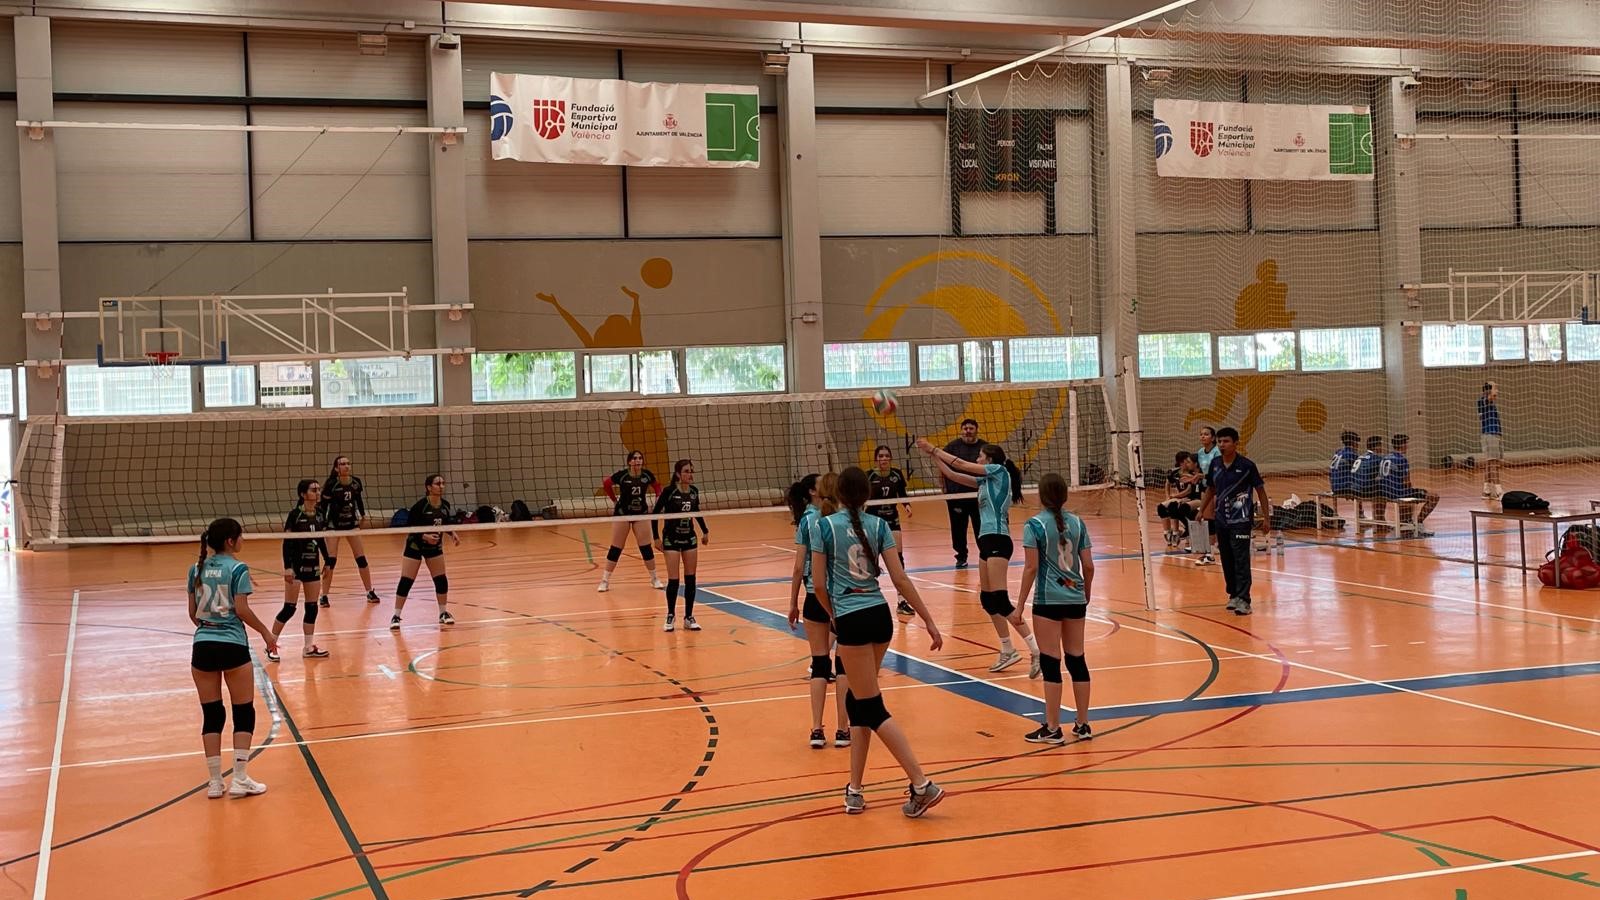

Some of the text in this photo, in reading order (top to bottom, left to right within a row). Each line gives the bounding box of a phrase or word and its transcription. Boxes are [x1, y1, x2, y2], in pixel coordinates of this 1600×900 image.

[571, 103, 615, 113] Fundació
[571, 113, 617, 123] Esportiva
[571, 122, 618, 132] Municipal
[1218, 124, 1253, 133] Fundació
[571, 131, 611, 140] València
[1218, 133, 1255, 142] Esportiva
[1218, 141, 1256, 150] Municipal
[961, 160, 978, 168] LOCAL
[1029, 160, 1057, 168] VISITANTE
[1351, 459, 1361, 473] 9
[1380, 459, 1392, 476] 10
[882, 486, 890, 496] 17
[1057, 538, 1073, 572] 8
[848, 543, 870, 580] 6
[195, 583, 230, 619] 24
